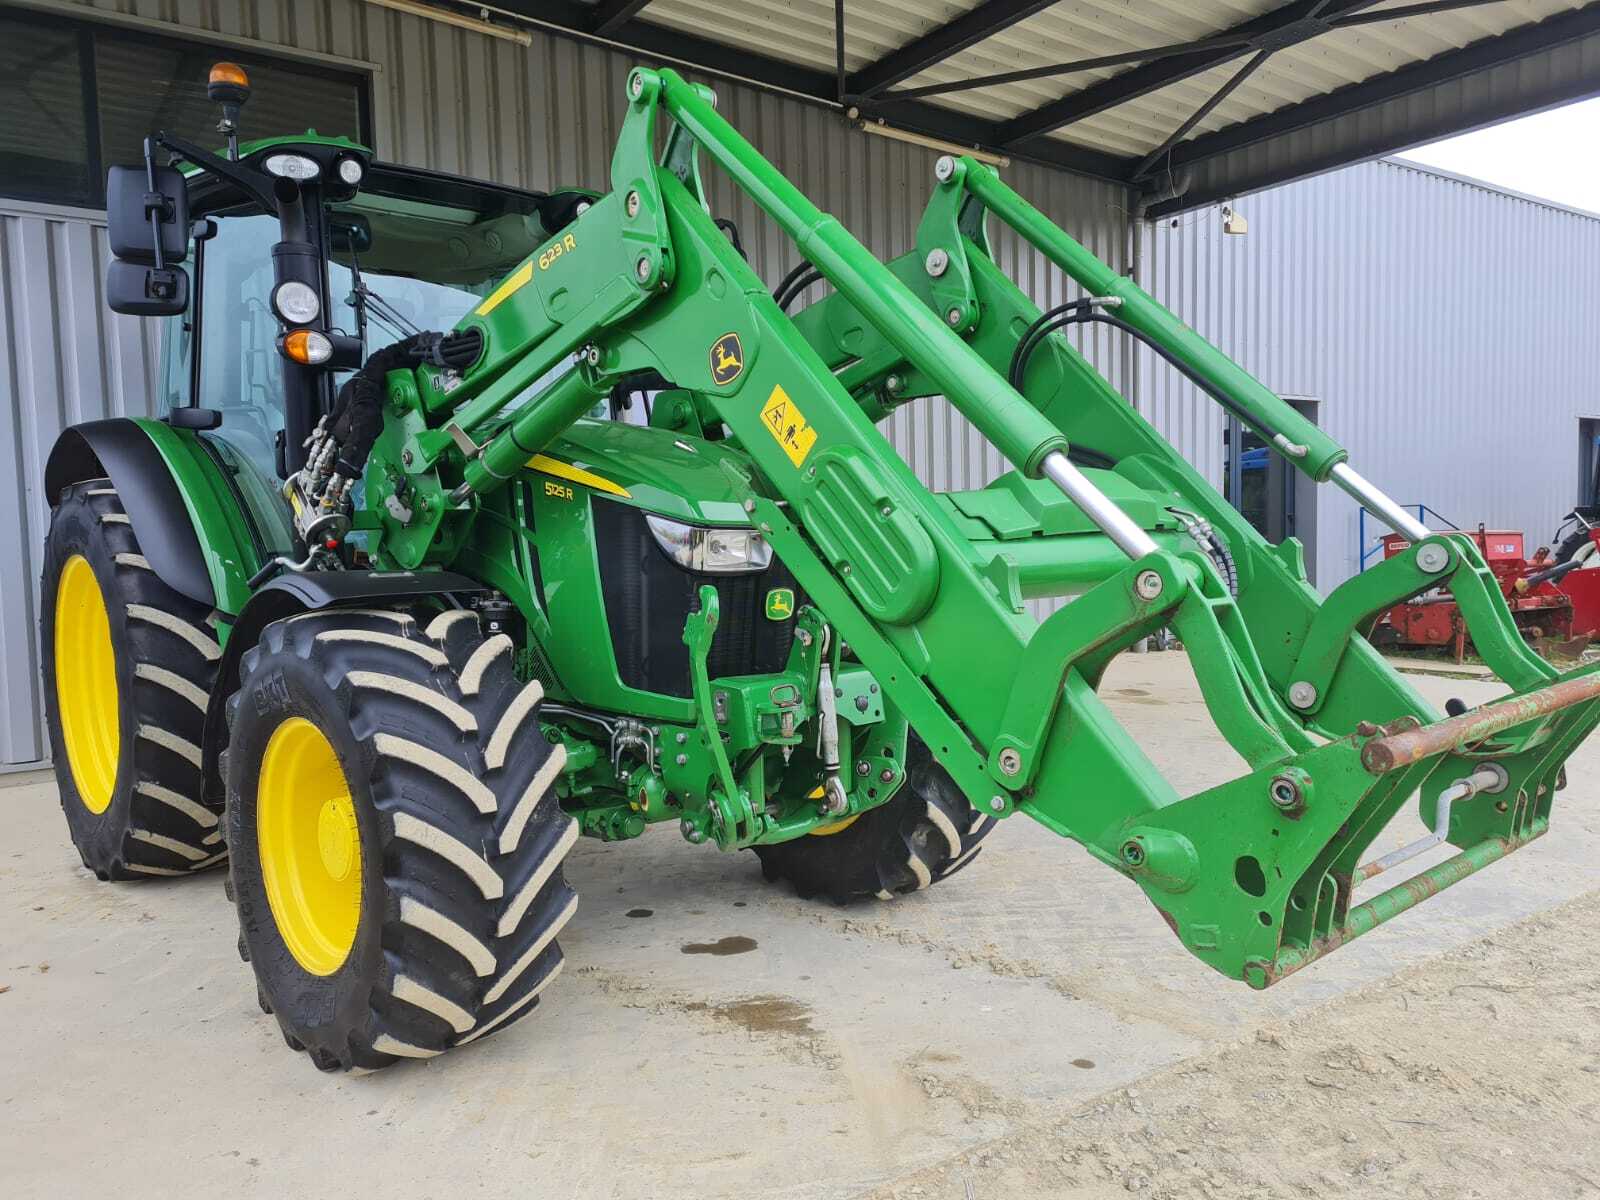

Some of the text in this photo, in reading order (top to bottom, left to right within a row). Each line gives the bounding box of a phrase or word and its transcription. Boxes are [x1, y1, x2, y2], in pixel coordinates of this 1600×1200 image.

[539, 233, 576, 270] 623 R
[566, 487, 574, 501] R
